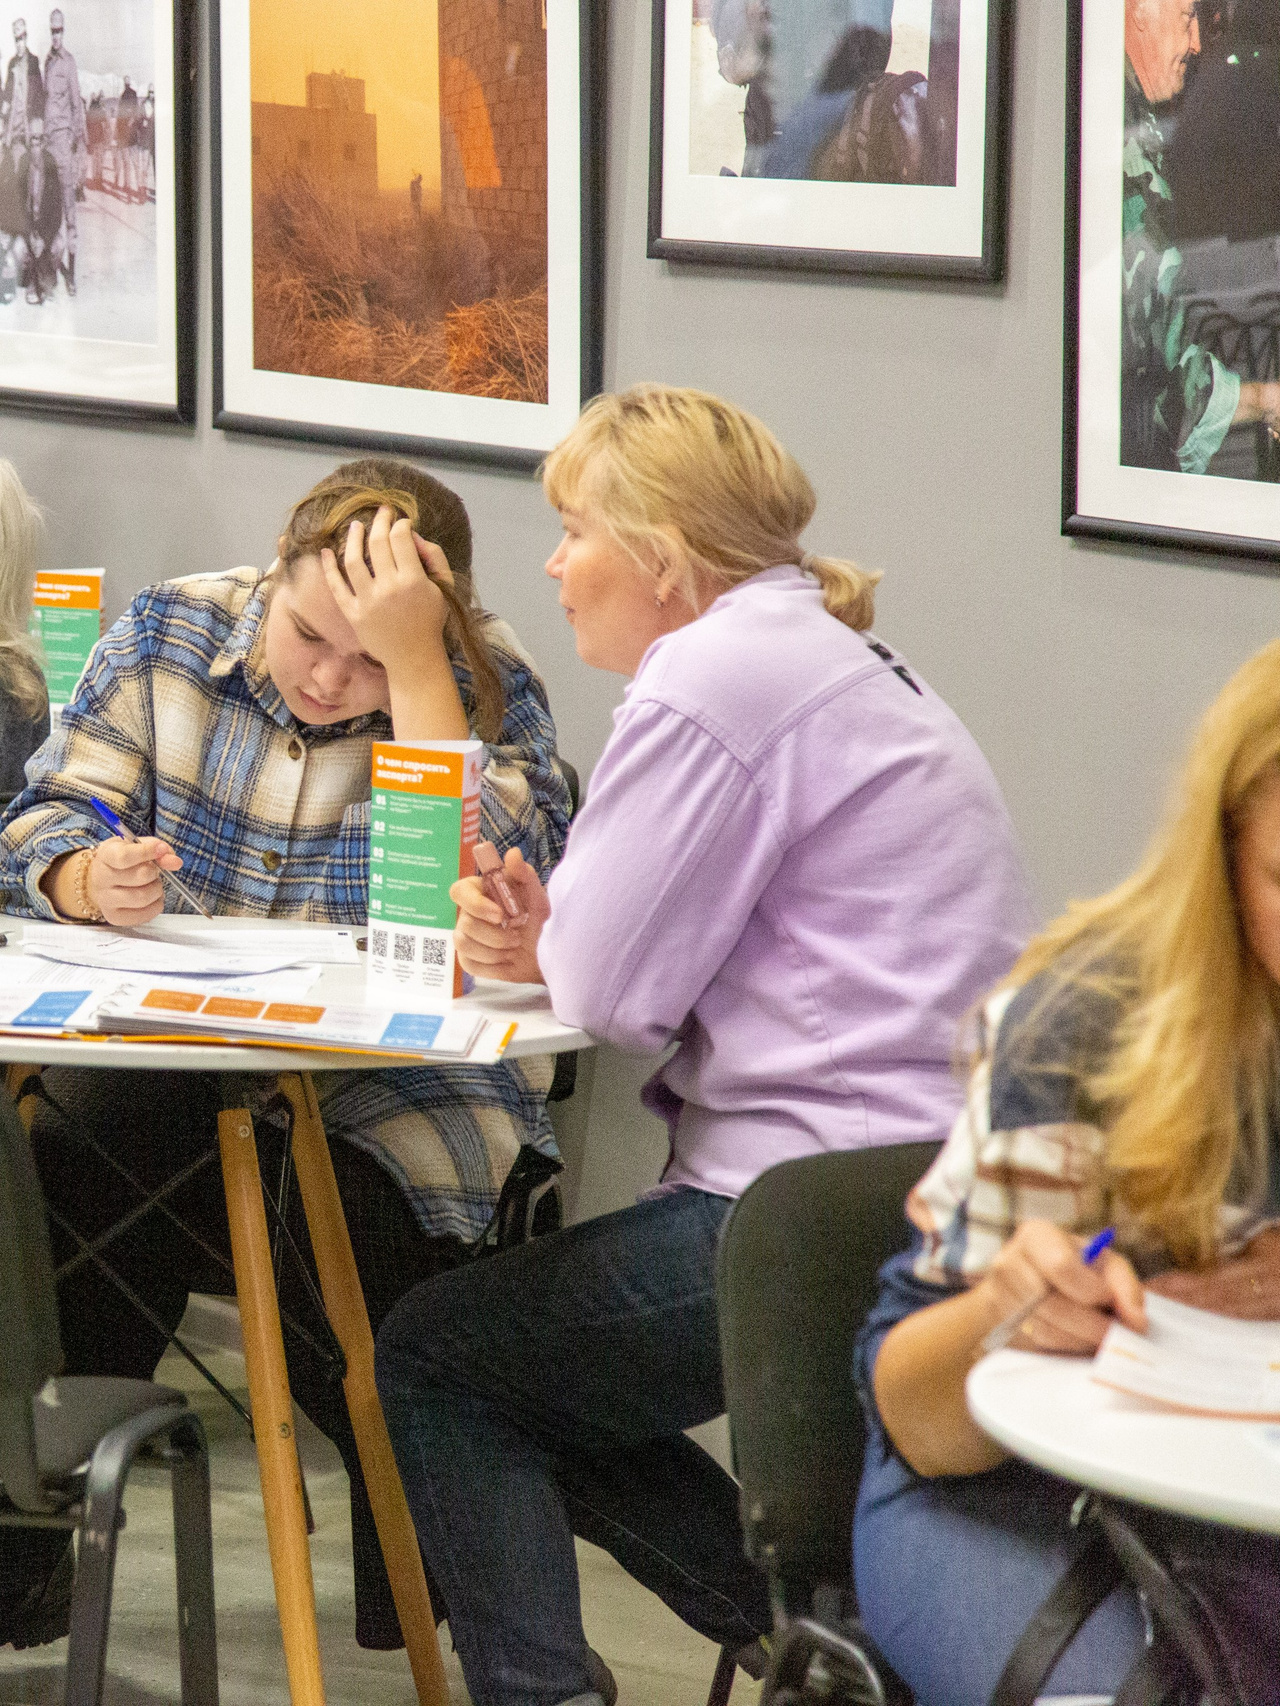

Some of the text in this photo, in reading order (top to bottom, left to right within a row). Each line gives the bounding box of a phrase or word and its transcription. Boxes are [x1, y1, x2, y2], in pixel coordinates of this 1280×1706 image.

[403, 761, 451, 774] спросить
[376, 769, 424, 784] эксперта?
[375, 794, 387, 806] 01
[374, 820, 386, 832] 02
[373, 846, 385, 858] 03
[372, 873, 383, 885] 04
